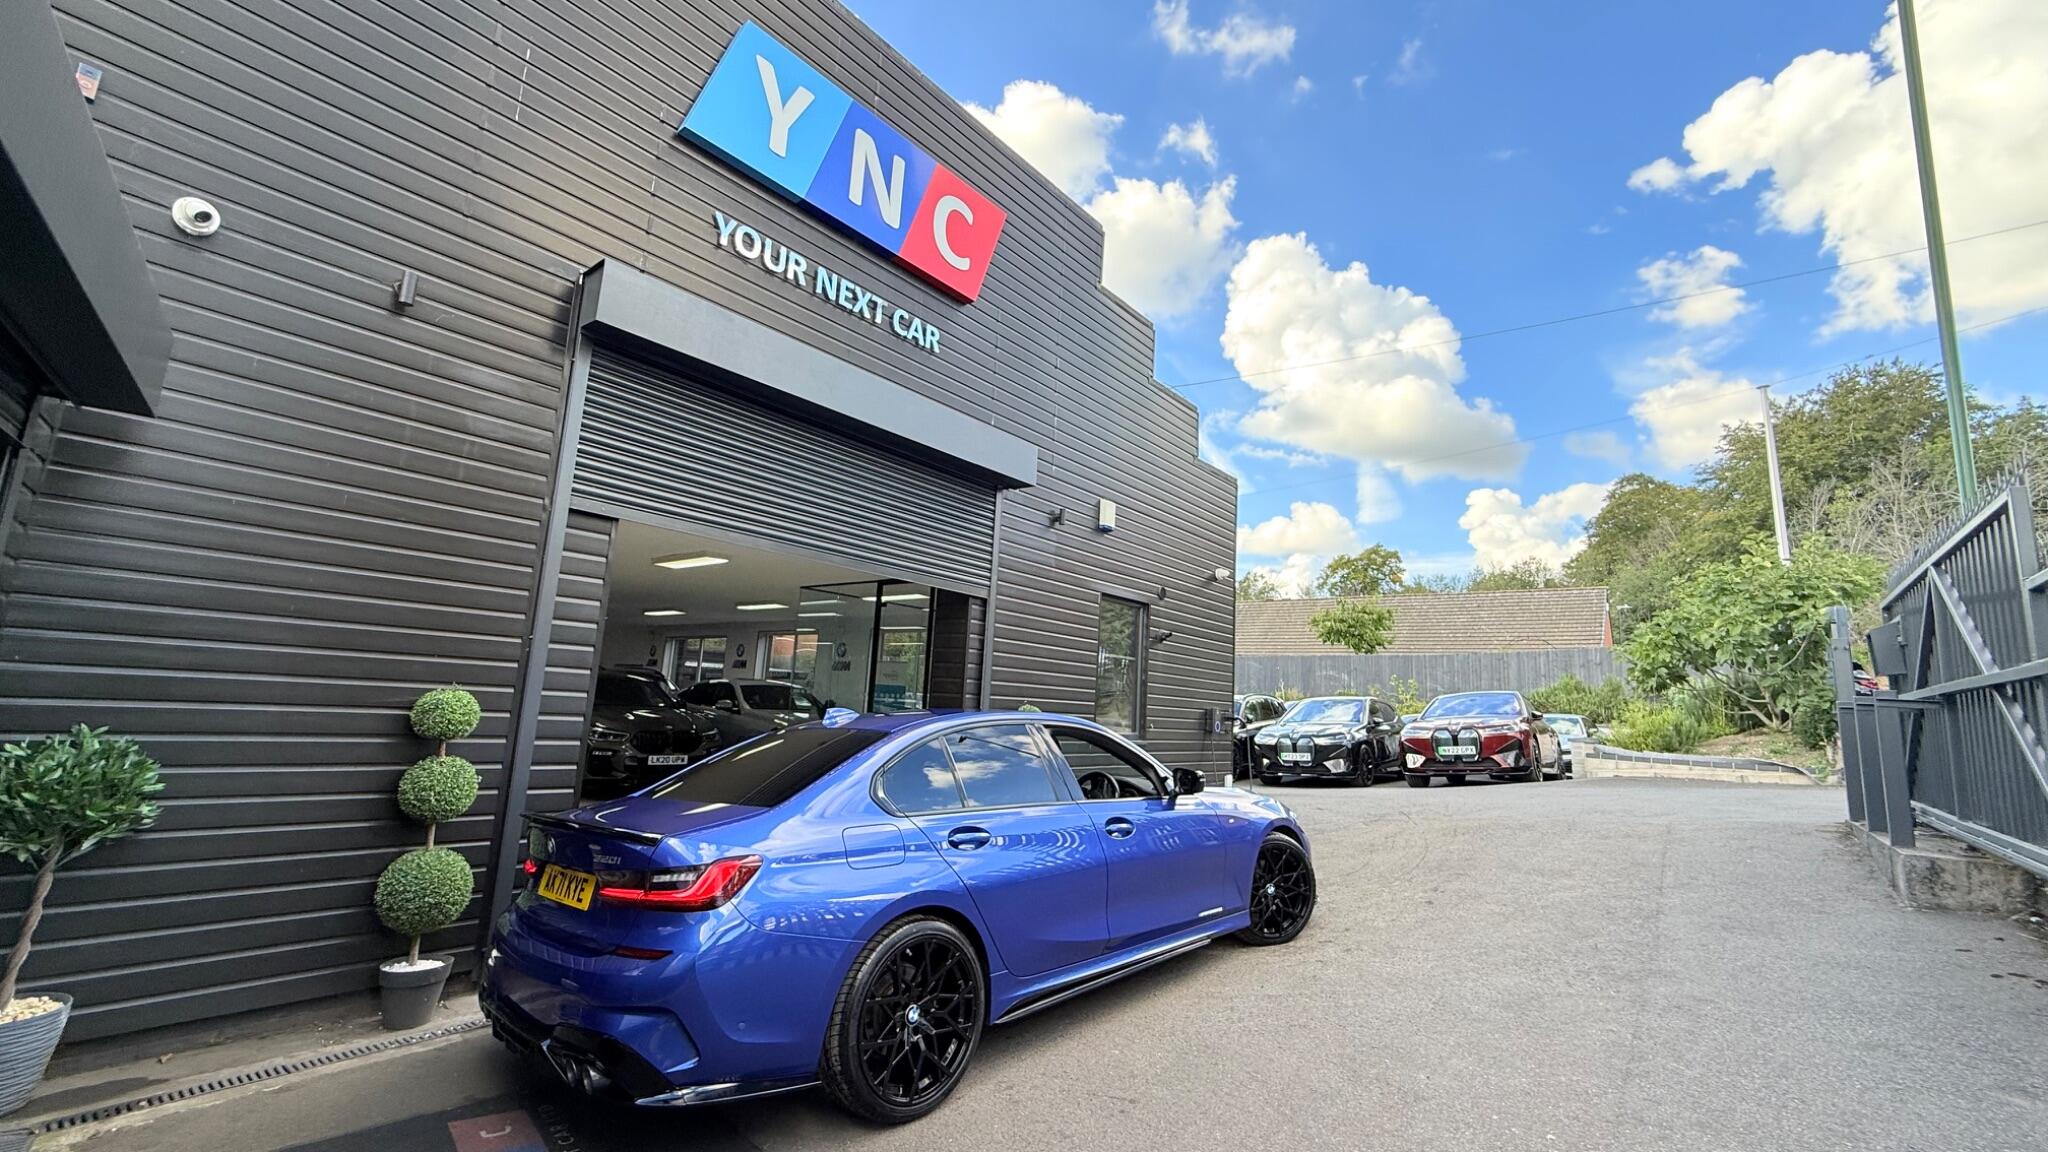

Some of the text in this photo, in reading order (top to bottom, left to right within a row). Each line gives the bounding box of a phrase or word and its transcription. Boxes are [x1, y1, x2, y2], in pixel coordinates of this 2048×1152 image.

[755, 54, 974, 271] YNC
[713, 210, 941, 354] YOUR NEXT CAR
[651, 756, 670, 764] LK20
